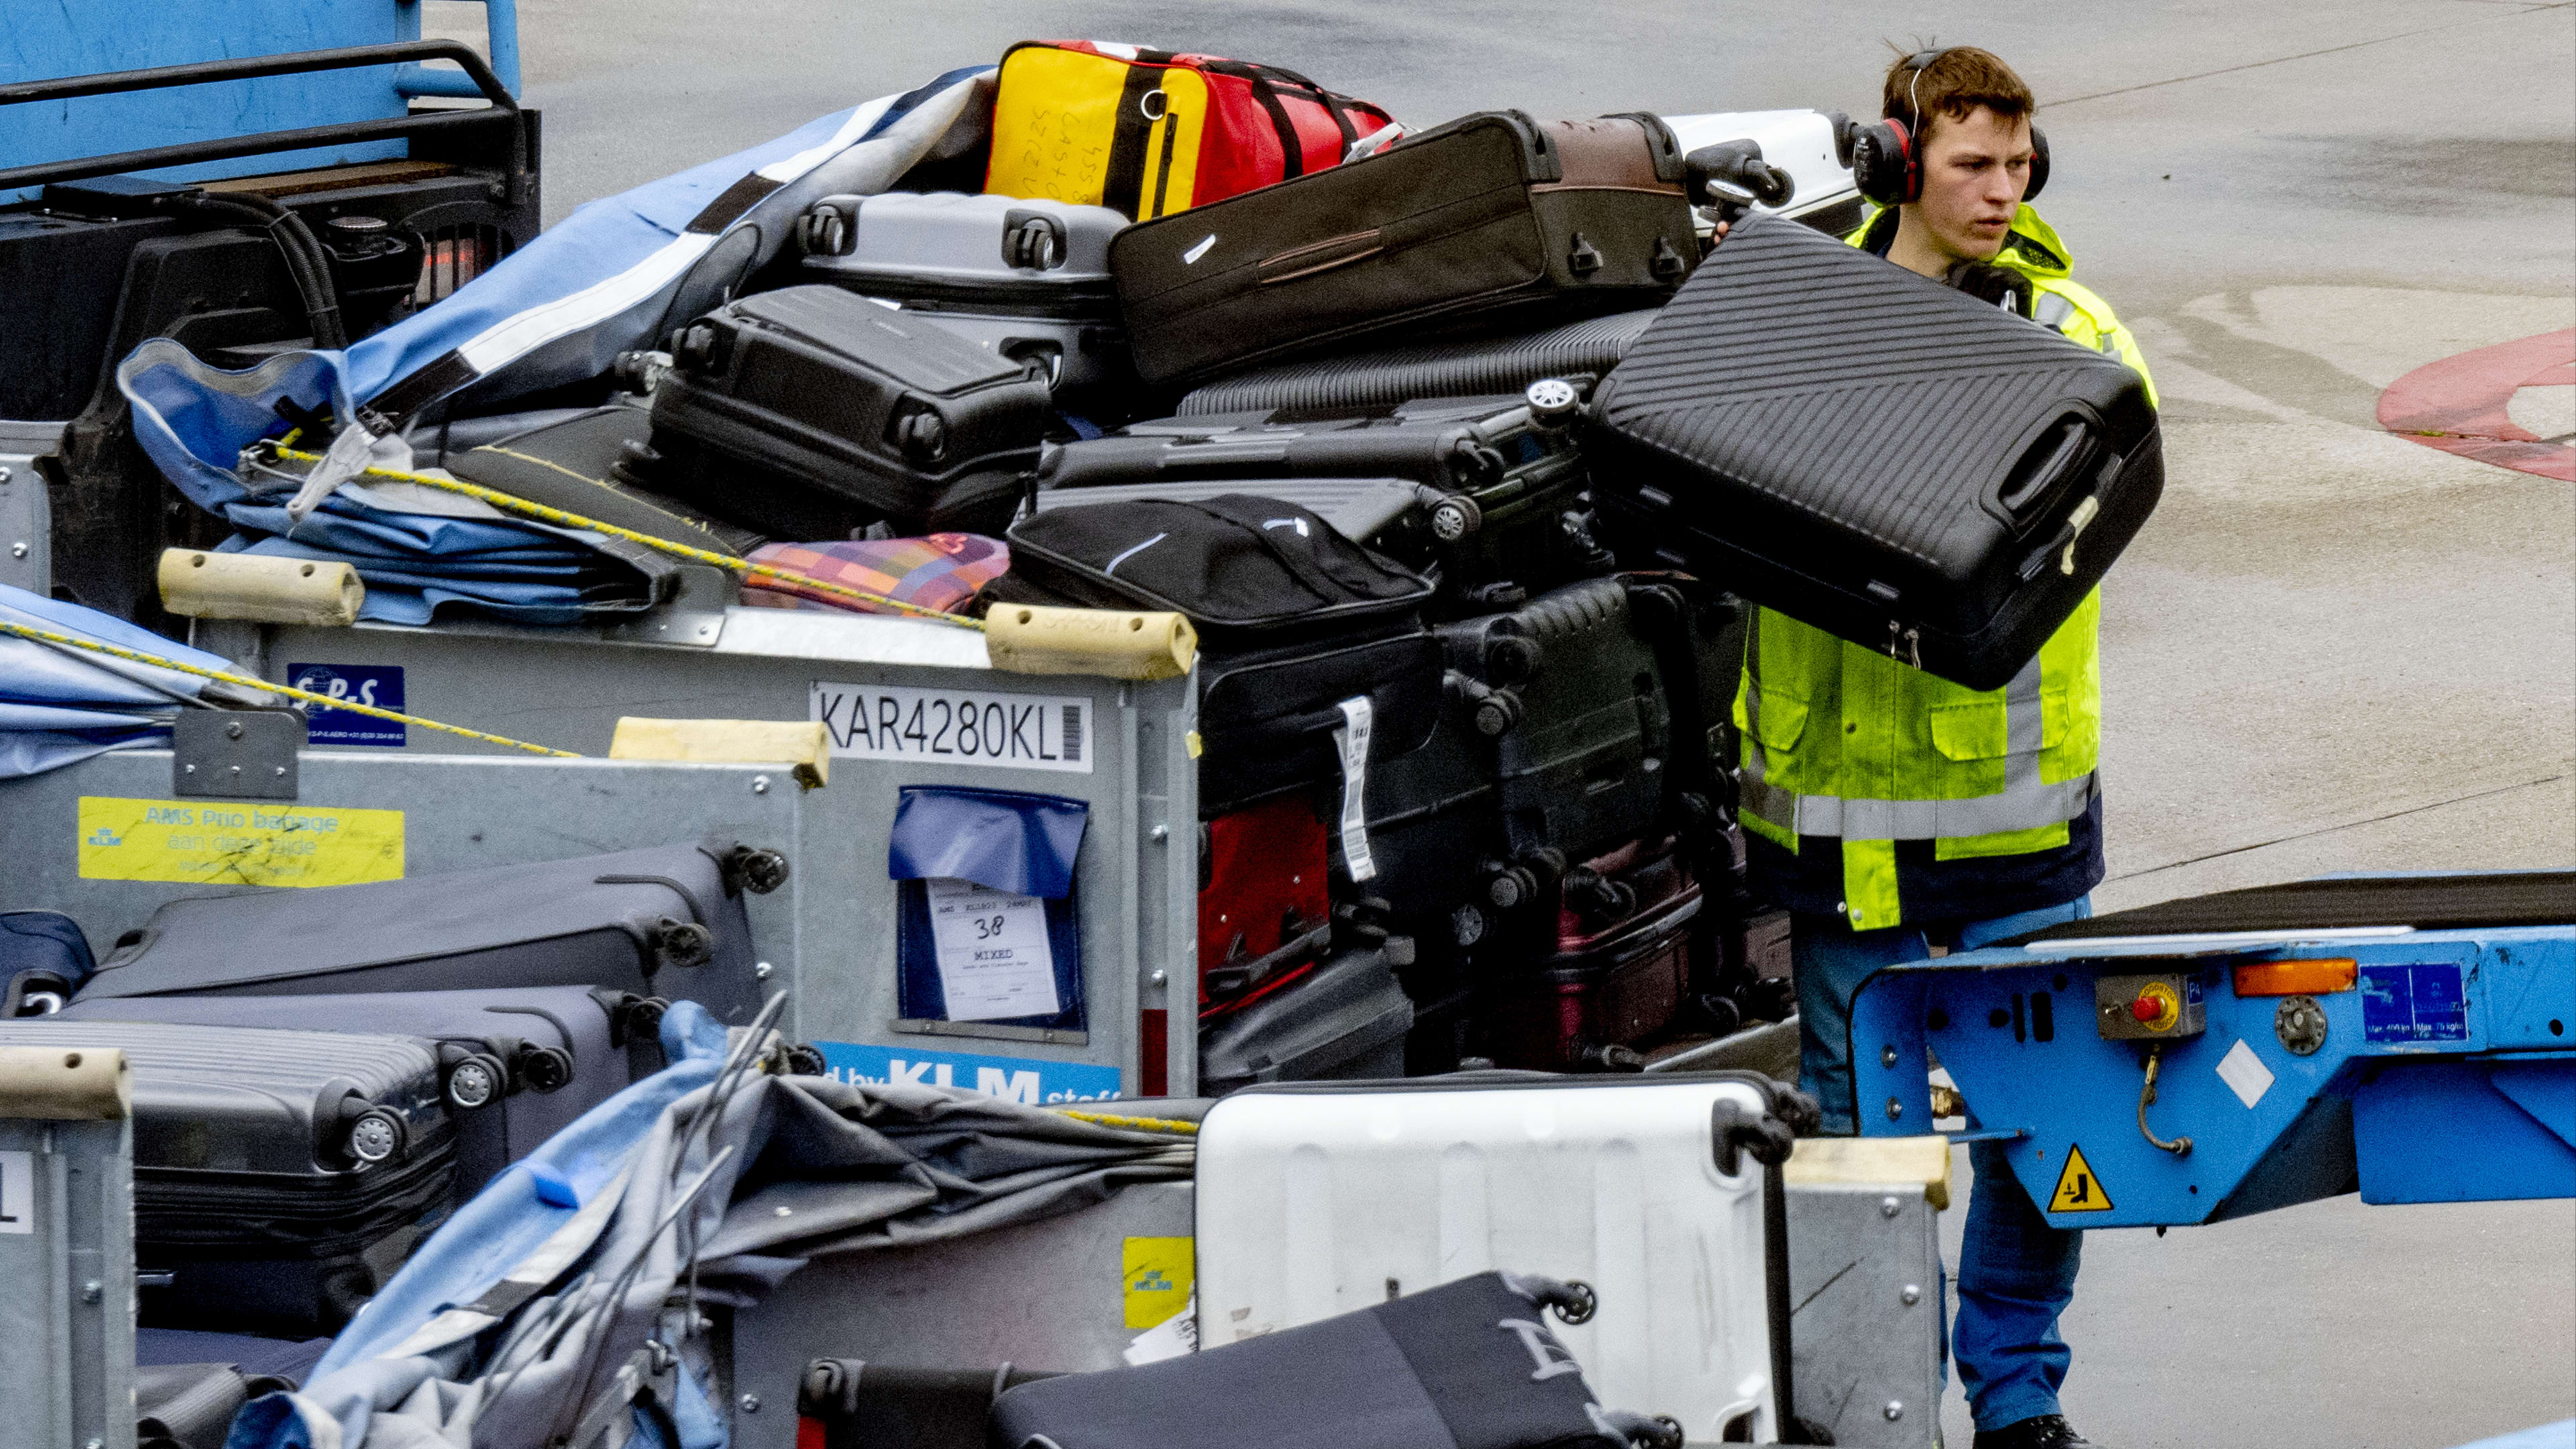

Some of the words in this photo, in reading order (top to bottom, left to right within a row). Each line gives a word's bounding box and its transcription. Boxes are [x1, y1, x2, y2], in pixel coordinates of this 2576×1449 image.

[820, 692, 1057, 761] KAR4280KL
[146, 807, 193, 825] AMS
[203, 810, 246, 828] Prio
[253, 810, 339, 835] bagage
[168, 837, 205, 849] aan
[974, 915, 1004, 939] 38
[974, 949, 1014, 961] MIXED
